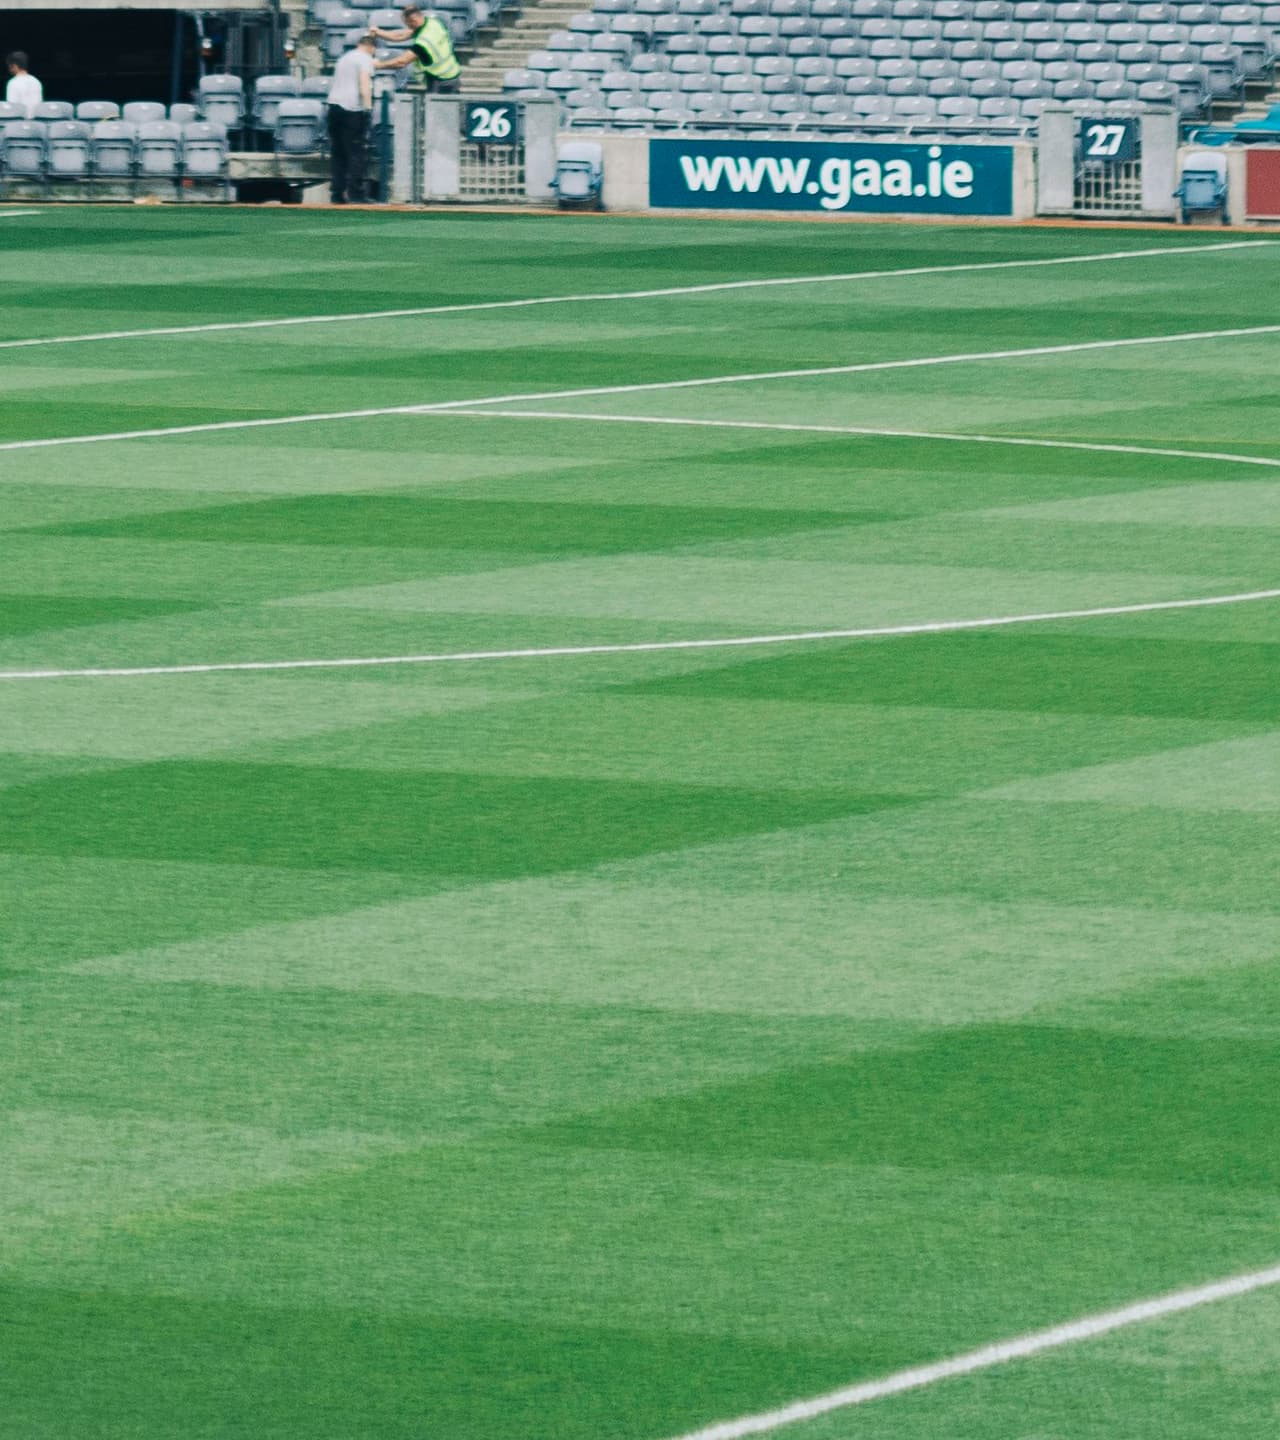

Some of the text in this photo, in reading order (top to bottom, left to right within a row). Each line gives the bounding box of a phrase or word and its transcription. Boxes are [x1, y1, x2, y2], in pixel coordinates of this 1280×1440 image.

[469, 107, 512, 138] 26
[1087, 124, 1126, 156] 27
[680, 146, 974, 210] www.gaa.ie
